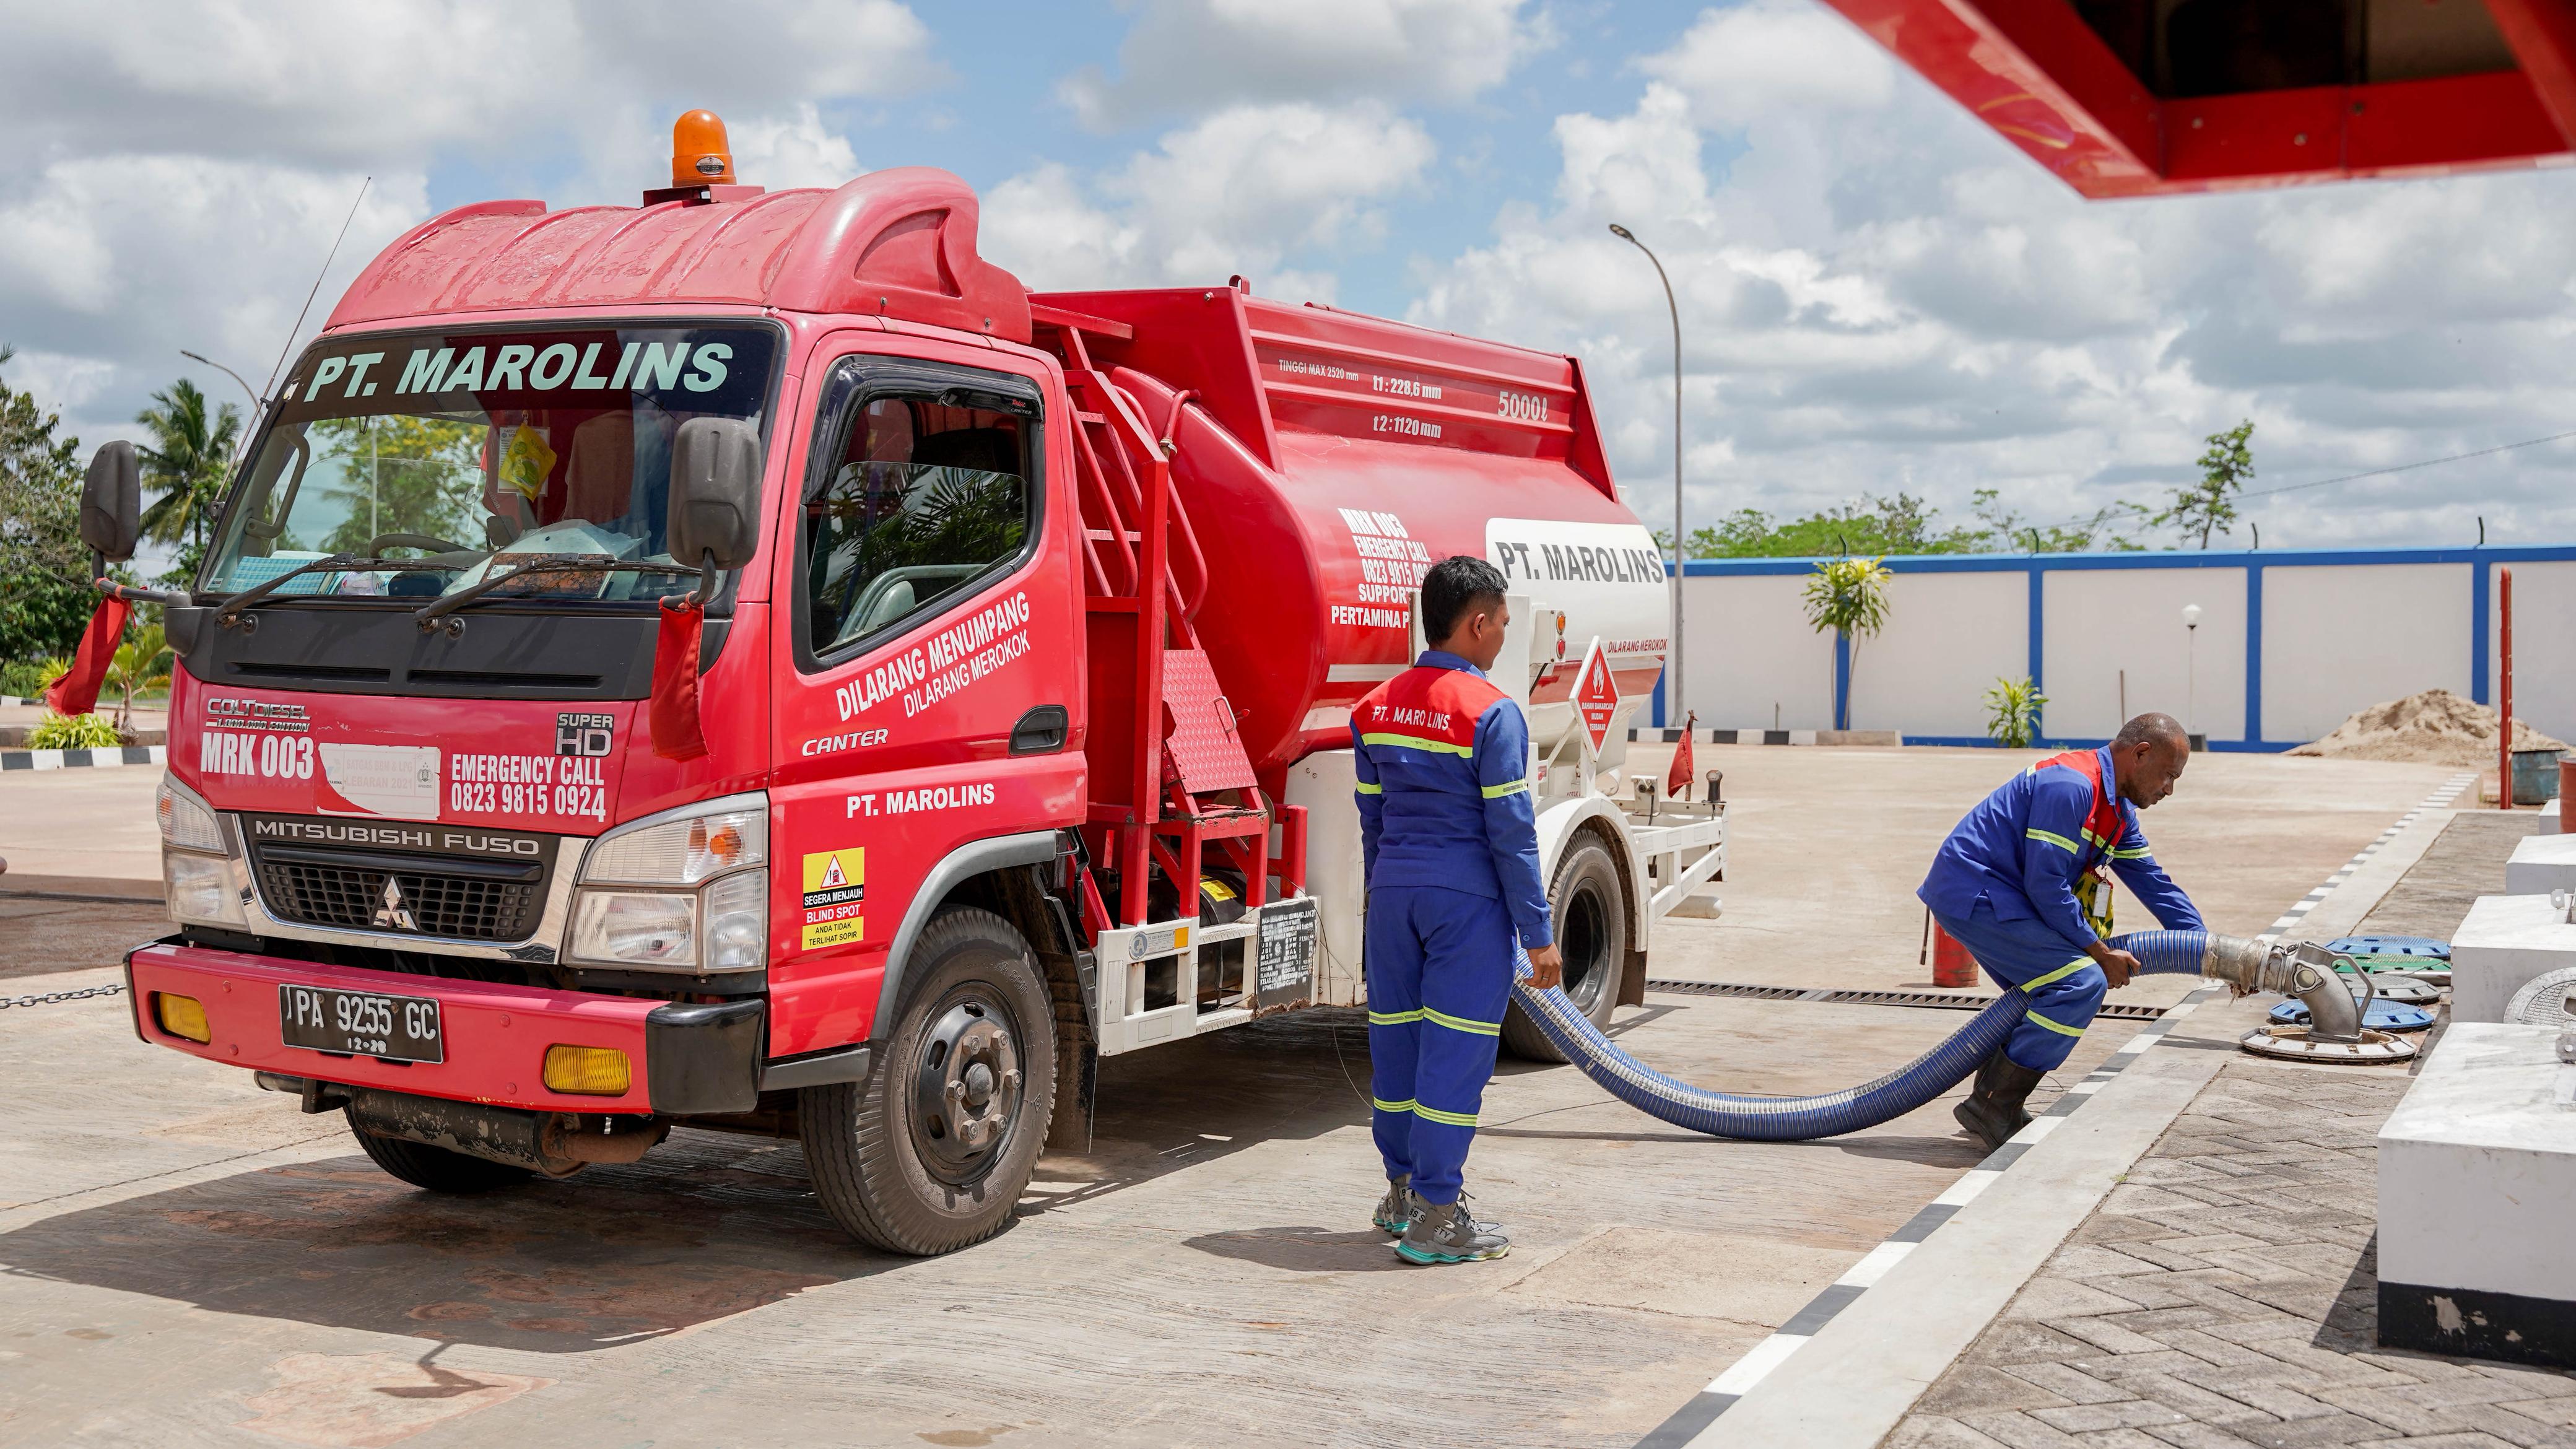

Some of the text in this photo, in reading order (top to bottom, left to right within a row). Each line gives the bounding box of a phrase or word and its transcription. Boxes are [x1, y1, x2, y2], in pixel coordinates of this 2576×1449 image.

[304, 342, 733, 402] PT. MAROLINS
[1279, 359, 1359, 381] TINGGI MAX 2520 mm
[1422, 386, 1442, 399] mm
[1394, 416, 1419, 436] 1120
[1420, 422, 1442, 439] mm
[1337, 508, 1409, 539] MRK 003
[1352, 535, 1432, 563] EMERGENCY CALL
[1495, 542, 1663, 583] PT. MAROLINS
[1362, 558, 1388, 584] 0823
[1387, 560, 1413, 586] 9815
[1331, 605, 1401, 629] PERTAMINA
[836, 591, 1030, 722] DILARANG MENUMPANG
[1608, 638, 1668, 653] DILARANG MEROKOK
[903, 629, 1031, 718] DILARANG MEROKOK
[269, 721, 311, 733] EDITION
[558, 714, 614, 728] SUPER
[1372, 706, 1389, 721] PT.
[201, 731, 314, 780] MRK 003
[556, 728, 612, 756] HD
[802, 728, 889, 757] CANTER
[346, 759, 372, 770] SATGAS
[451, 754, 604, 785] EMERGENCY CALL
[346, 775, 413, 790] LEBARAN 2021
[451, 782, 606, 822] 0823 9815 0924
[847, 783, 995, 818] PT. MAROLINS
[256, 820, 539, 855] MITSUBISHI FUSO
[804, 888, 863, 906] SEGERA MENJAUH
[806, 904, 861, 923] BLIND SPOT
[815, 921, 851, 934] ANDA TIDAK
[809, 931, 857, 946] TERLIHAT SOPIR
[296, 990, 436, 1040] PA 9255 GC
